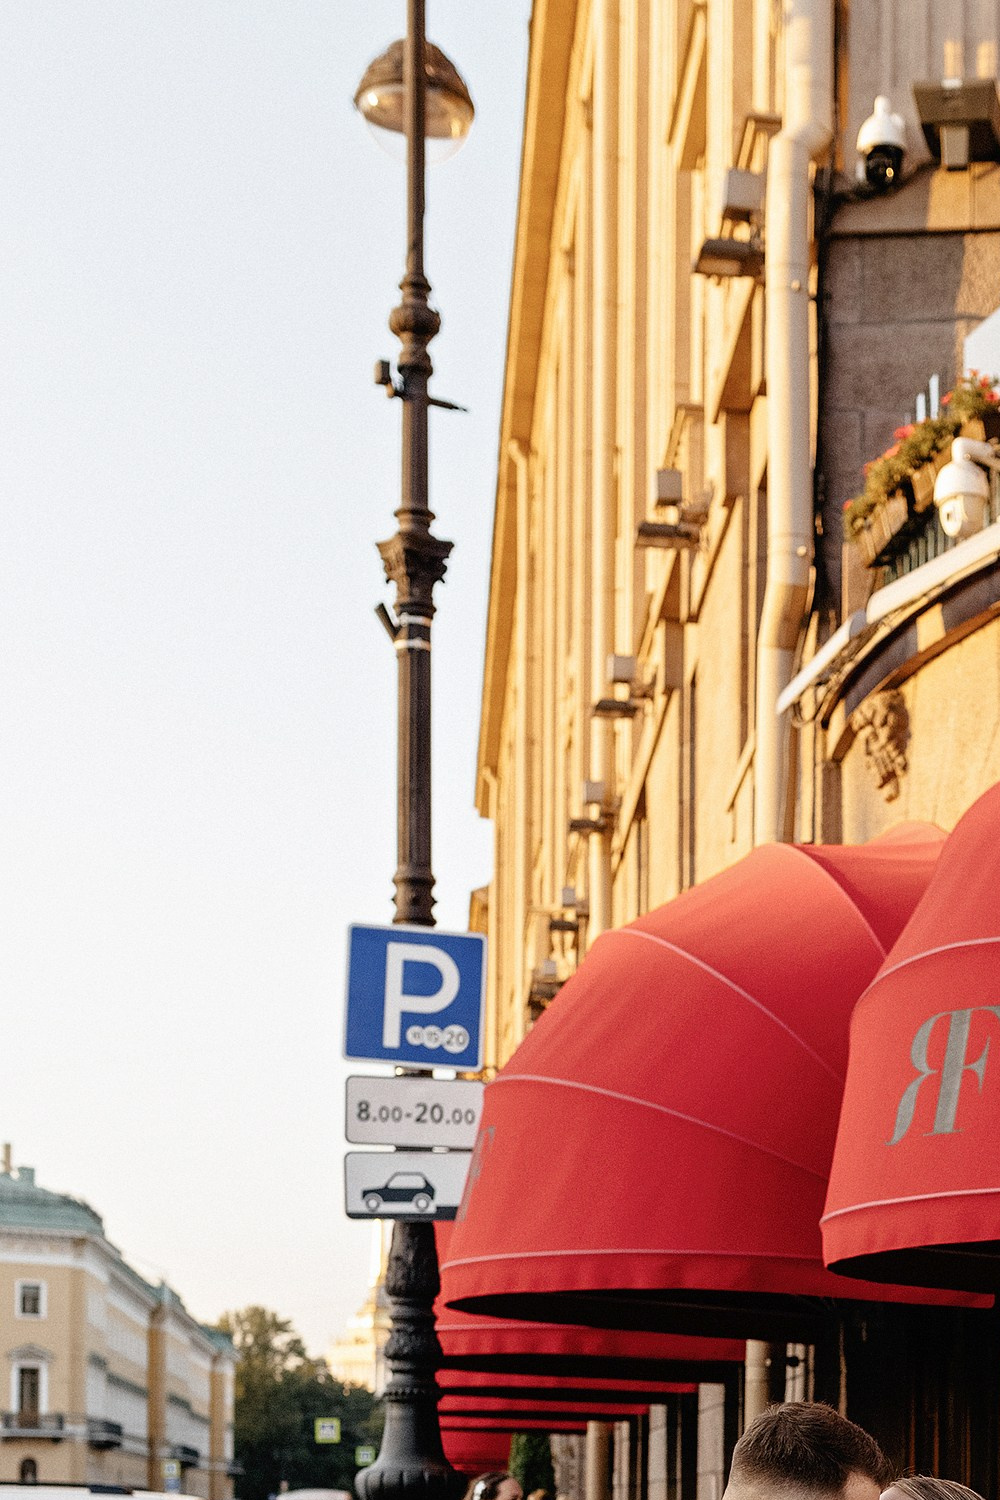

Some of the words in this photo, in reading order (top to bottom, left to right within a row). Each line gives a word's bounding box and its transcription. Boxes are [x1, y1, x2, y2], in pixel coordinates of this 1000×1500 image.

[383, 942, 460, 1048] P
[446, 1031, 467, 1047] 20
[357, 1100, 476, 1125] 8.00-20.00
